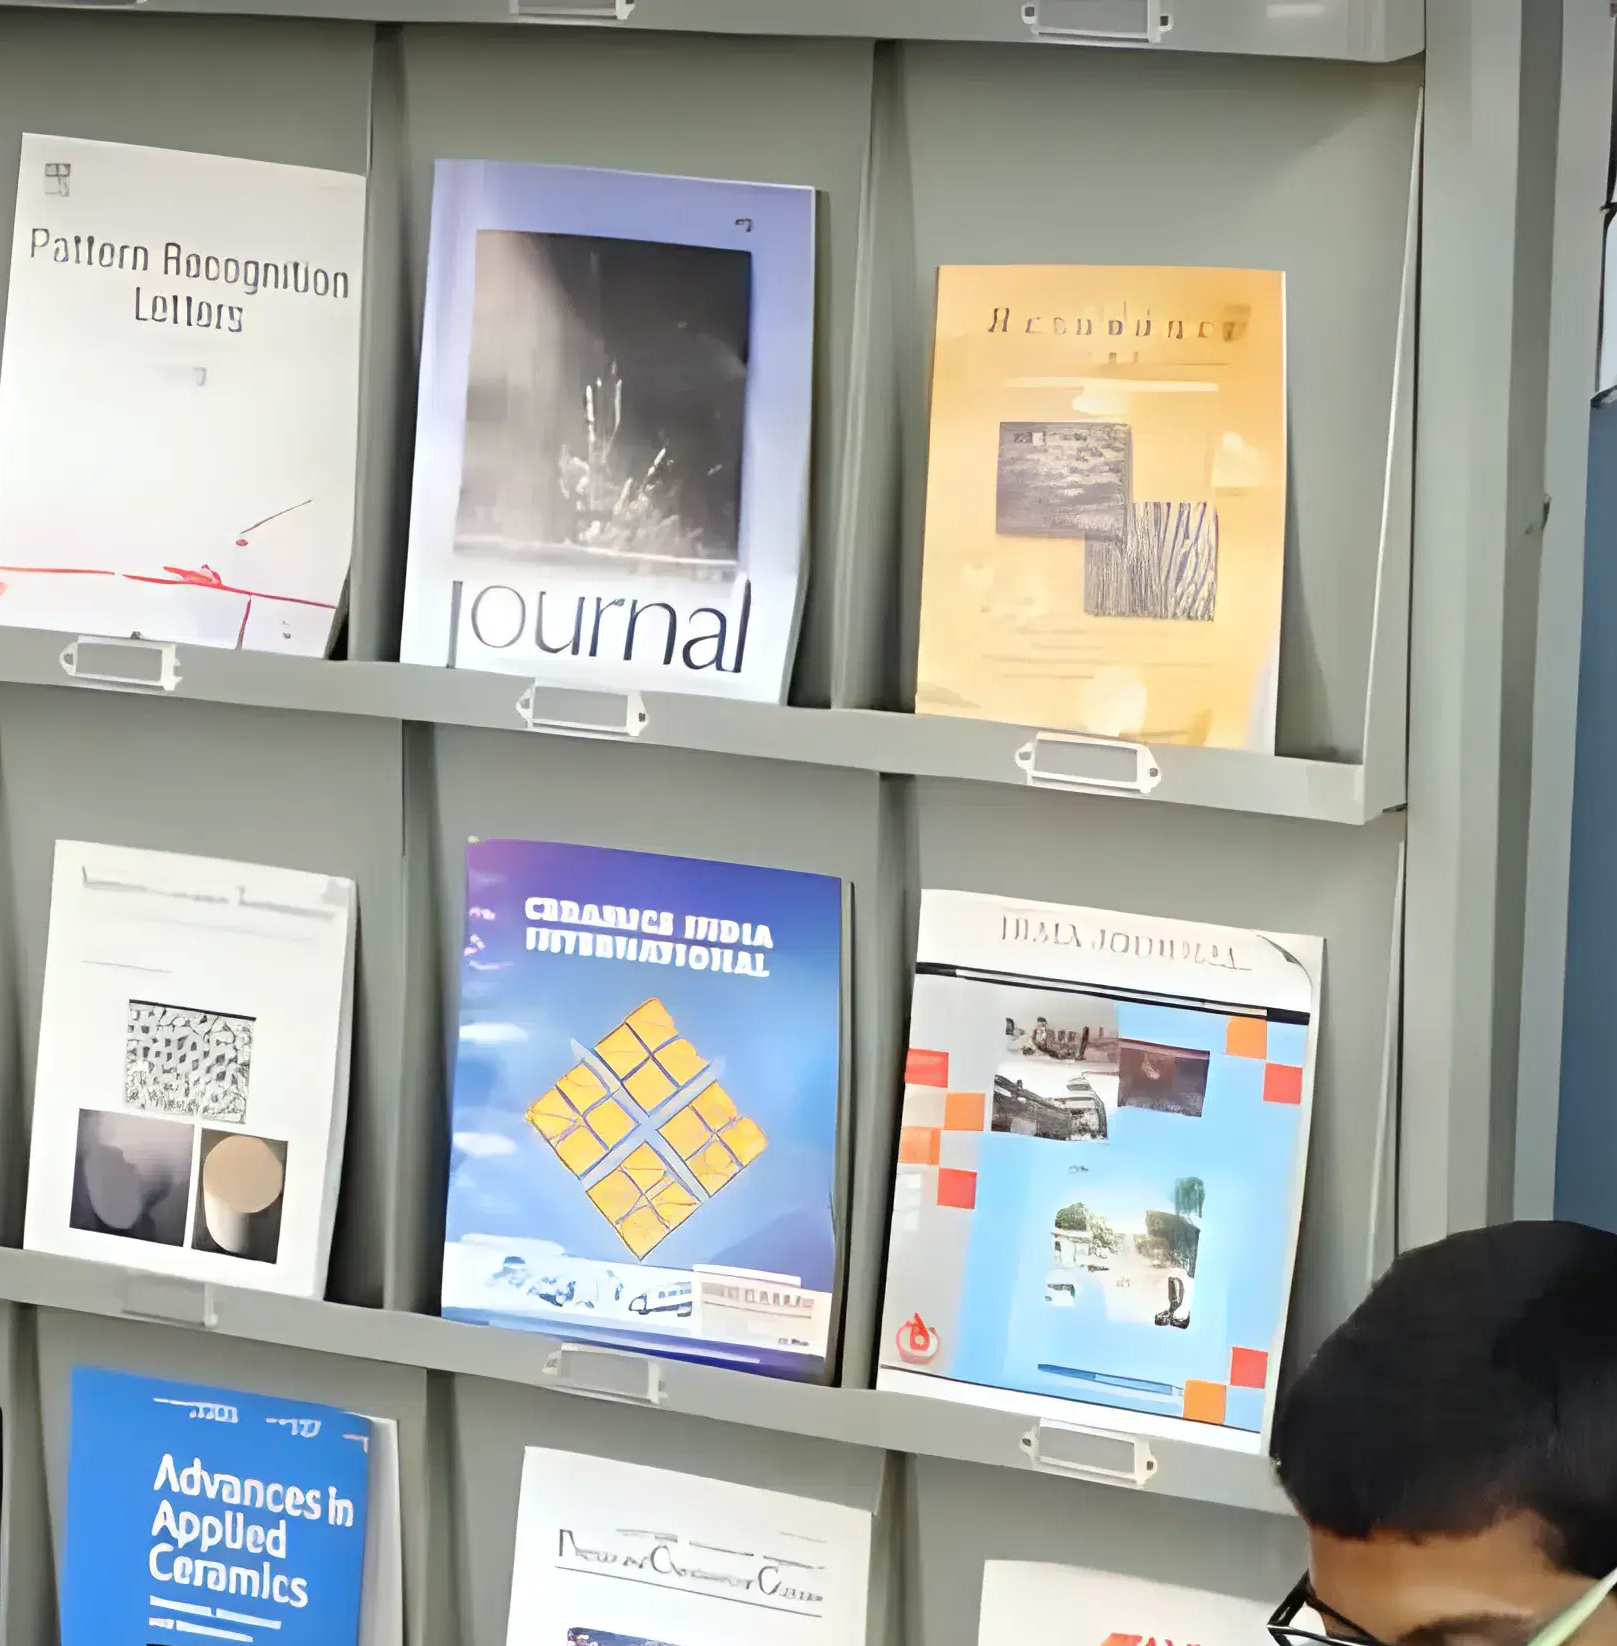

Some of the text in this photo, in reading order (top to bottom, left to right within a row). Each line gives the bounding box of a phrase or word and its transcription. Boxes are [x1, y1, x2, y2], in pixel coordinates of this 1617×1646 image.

[153, 1452, 355, 1528] Advances in
[151, 1498, 287, 1560] Applied
[148, 1542, 309, 1609] Ceramics
